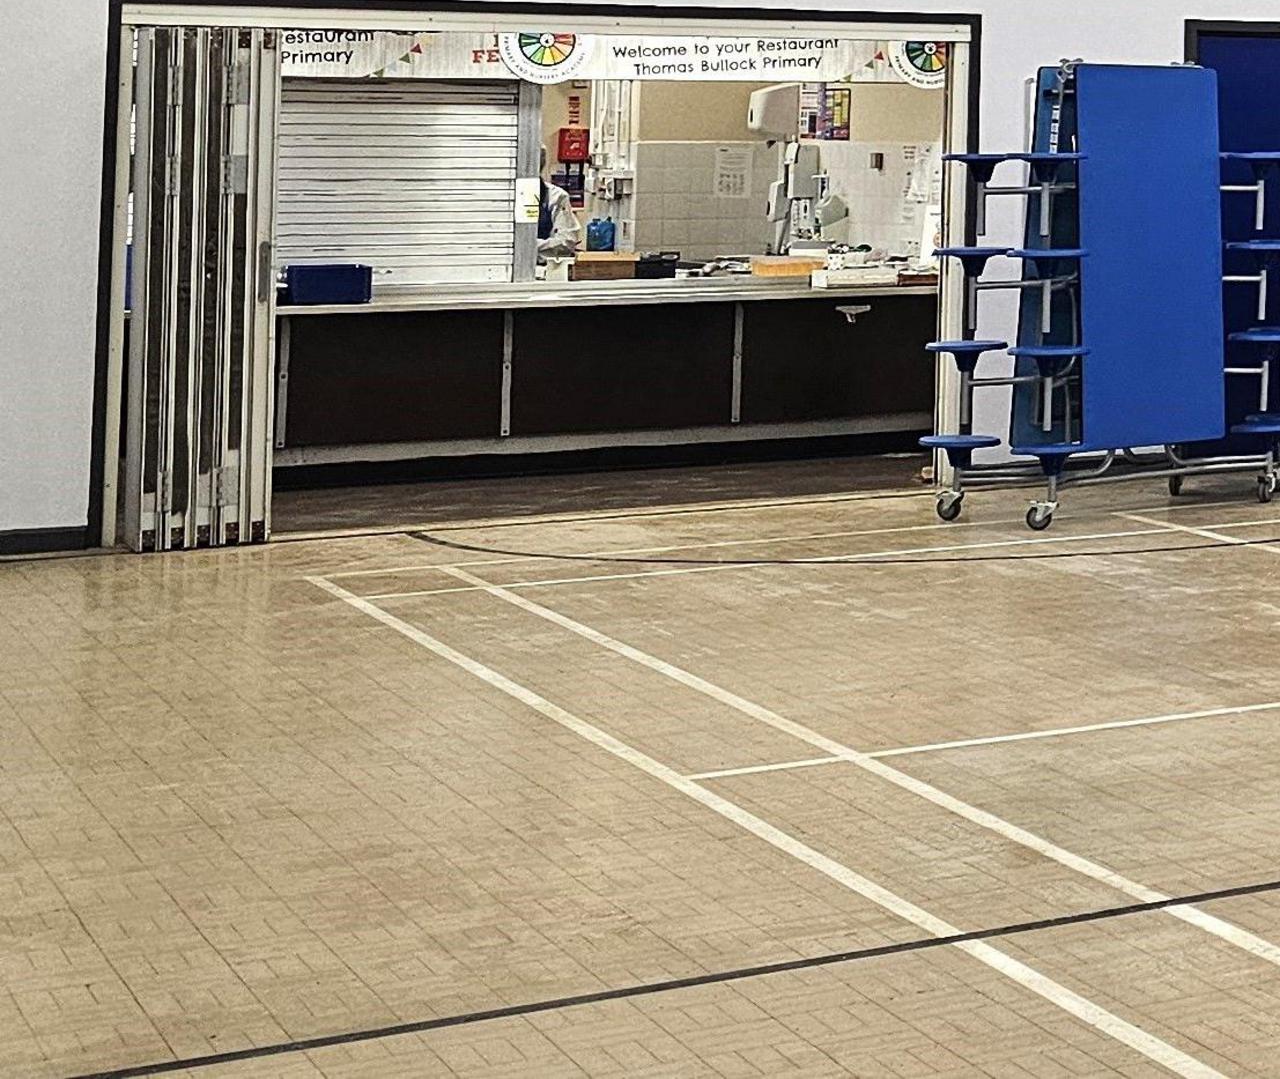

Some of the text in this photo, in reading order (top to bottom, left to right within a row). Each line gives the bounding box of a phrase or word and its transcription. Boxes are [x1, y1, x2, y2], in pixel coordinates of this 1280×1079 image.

[281, 50, 353, 64] Primary
[613, 38, 839, 58] Welcome to your Restaurant
[633, 55, 822, 76] Thomas Bullock Primary
